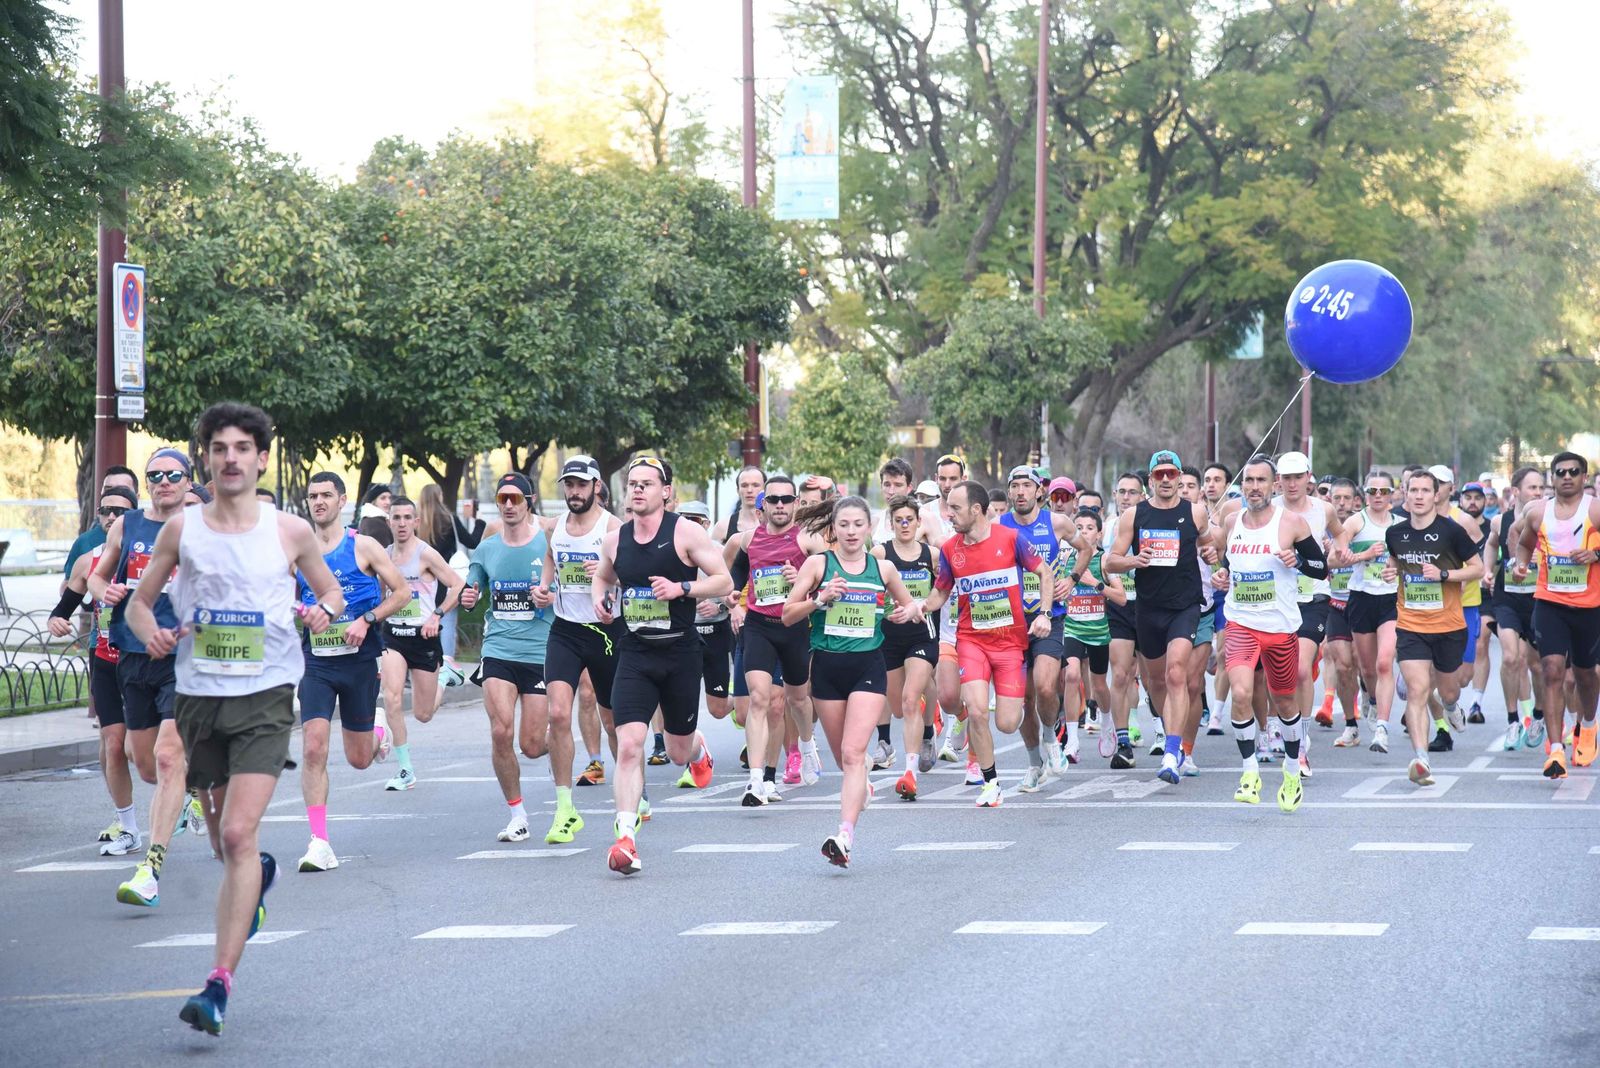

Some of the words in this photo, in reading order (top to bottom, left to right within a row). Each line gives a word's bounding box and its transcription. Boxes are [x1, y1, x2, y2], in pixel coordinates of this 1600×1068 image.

[1311, 284, 1355, 320] 2:45
[764, 567, 782, 575] ZURIC
[1244, 573, 1268, 581] ZURICH
[1554, 576, 1579, 584] ARJUN
[973, 576, 1009, 588] Avanza
[504, 593, 519, 601] 3714
[756, 587, 779, 598] MIGUE
[981, 591, 1004, 600] ZURICH
[1235, 592, 1273, 602] CANTANO
[1406, 593, 1440, 601] BAPTISTE
[844, 594, 872, 602] ZURICH
[497, 601, 530, 611] MARSAC
[1068, 605, 1091, 614] PACER
[214, 613, 257, 623] ZURICH
[971, 613, 990, 621] FRAN
[990, 609, 1012, 620] MORA
[837, 615, 864, 627] ALICE
[217, 633, 236, 642] 1721
[205, 644, 251, 659] GUTIPE
